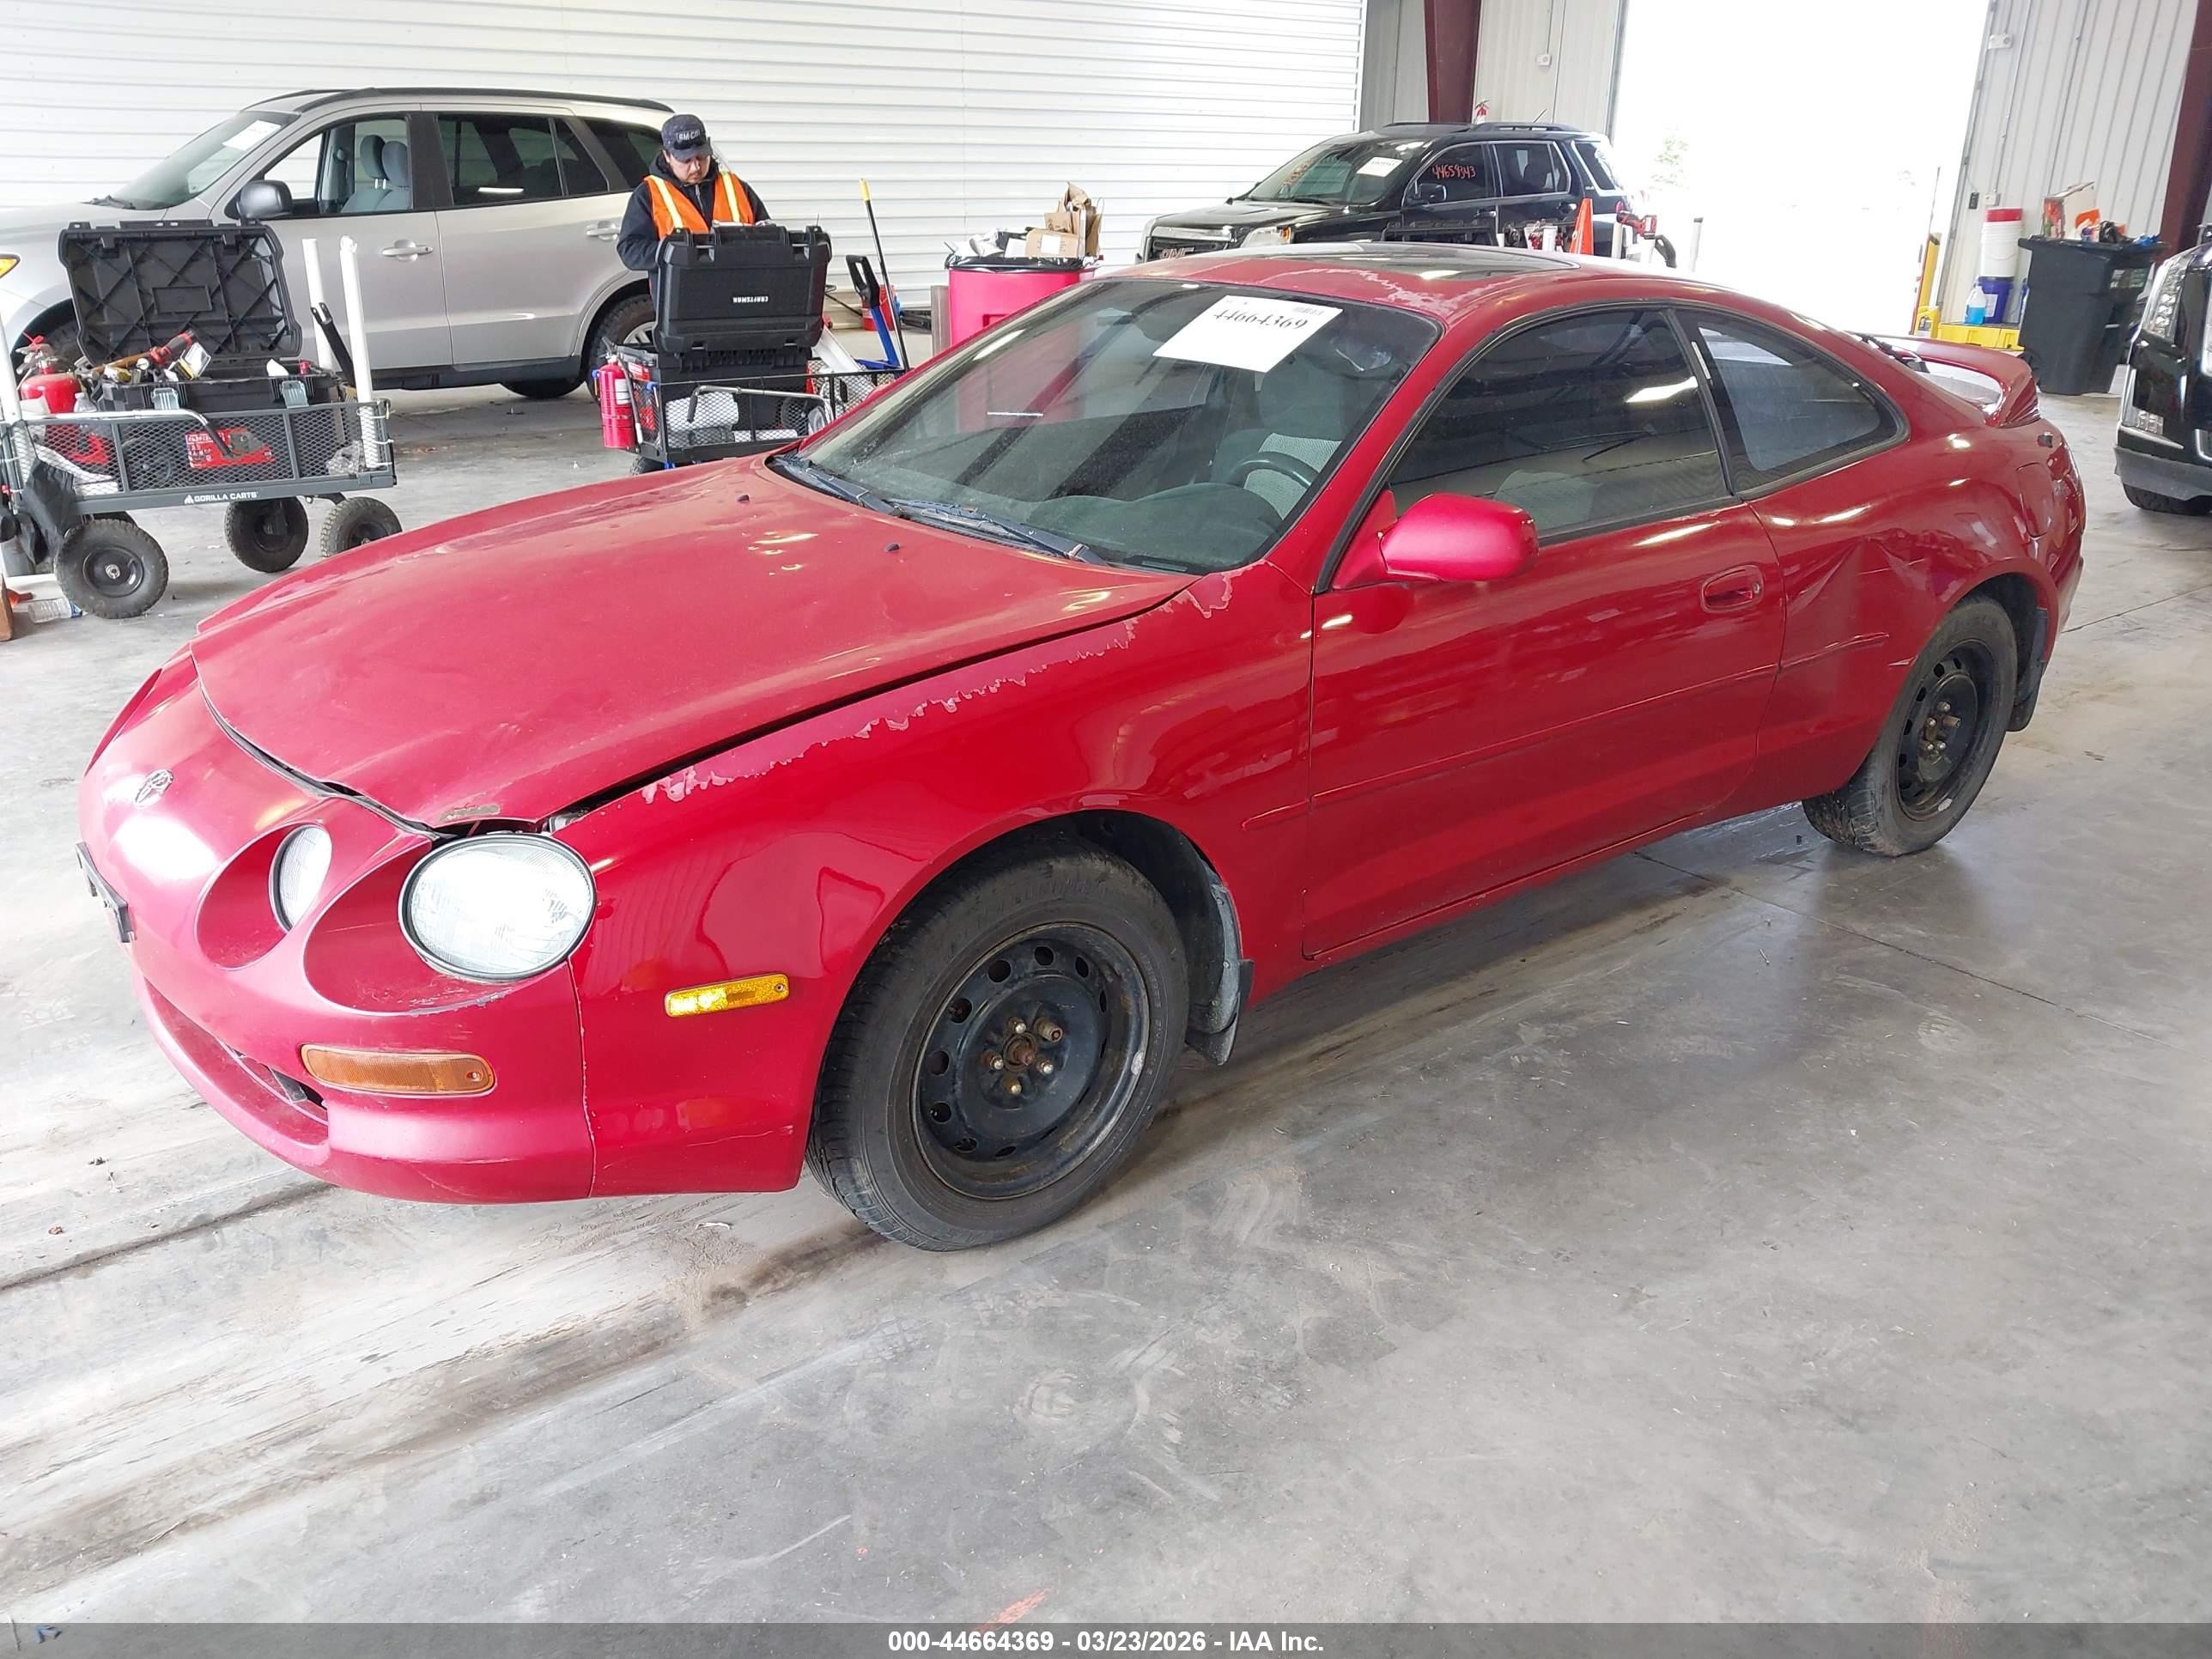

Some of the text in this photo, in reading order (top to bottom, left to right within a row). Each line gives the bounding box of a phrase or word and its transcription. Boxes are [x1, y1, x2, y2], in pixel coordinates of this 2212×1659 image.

[1431, 164, 1476, 179] 44659343
[1213, 309, 1308, 330] 44664369
[193, 491, 258, 502] GORILLA CARTS
